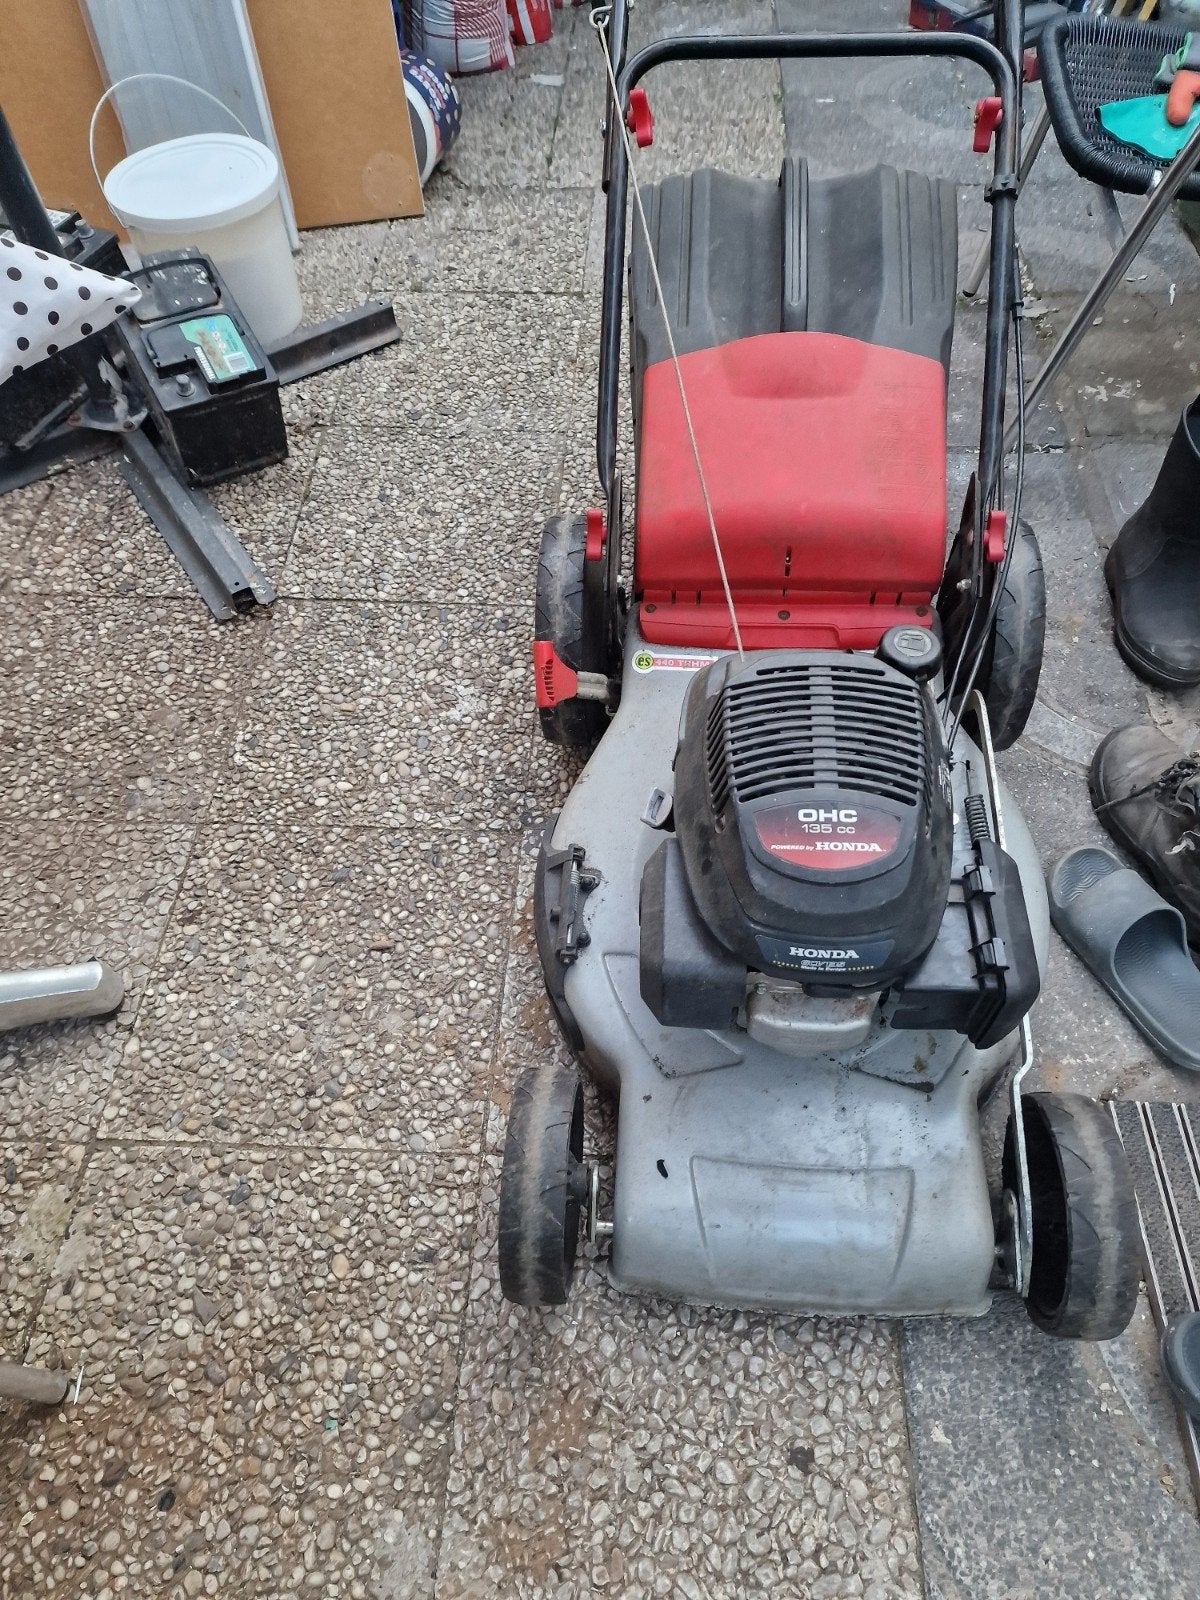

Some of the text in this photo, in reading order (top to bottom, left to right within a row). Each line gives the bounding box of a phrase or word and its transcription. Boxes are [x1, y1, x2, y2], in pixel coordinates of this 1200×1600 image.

[638, 656, 651, 666] es
[655, 658, 674, 667] 440
[798, 808, 858, 823] OHC
[801, 823, 856, 834] 135 cc
[815, 841, 883, 852] HONDA
[789, 946, 860, 958] HONDA
